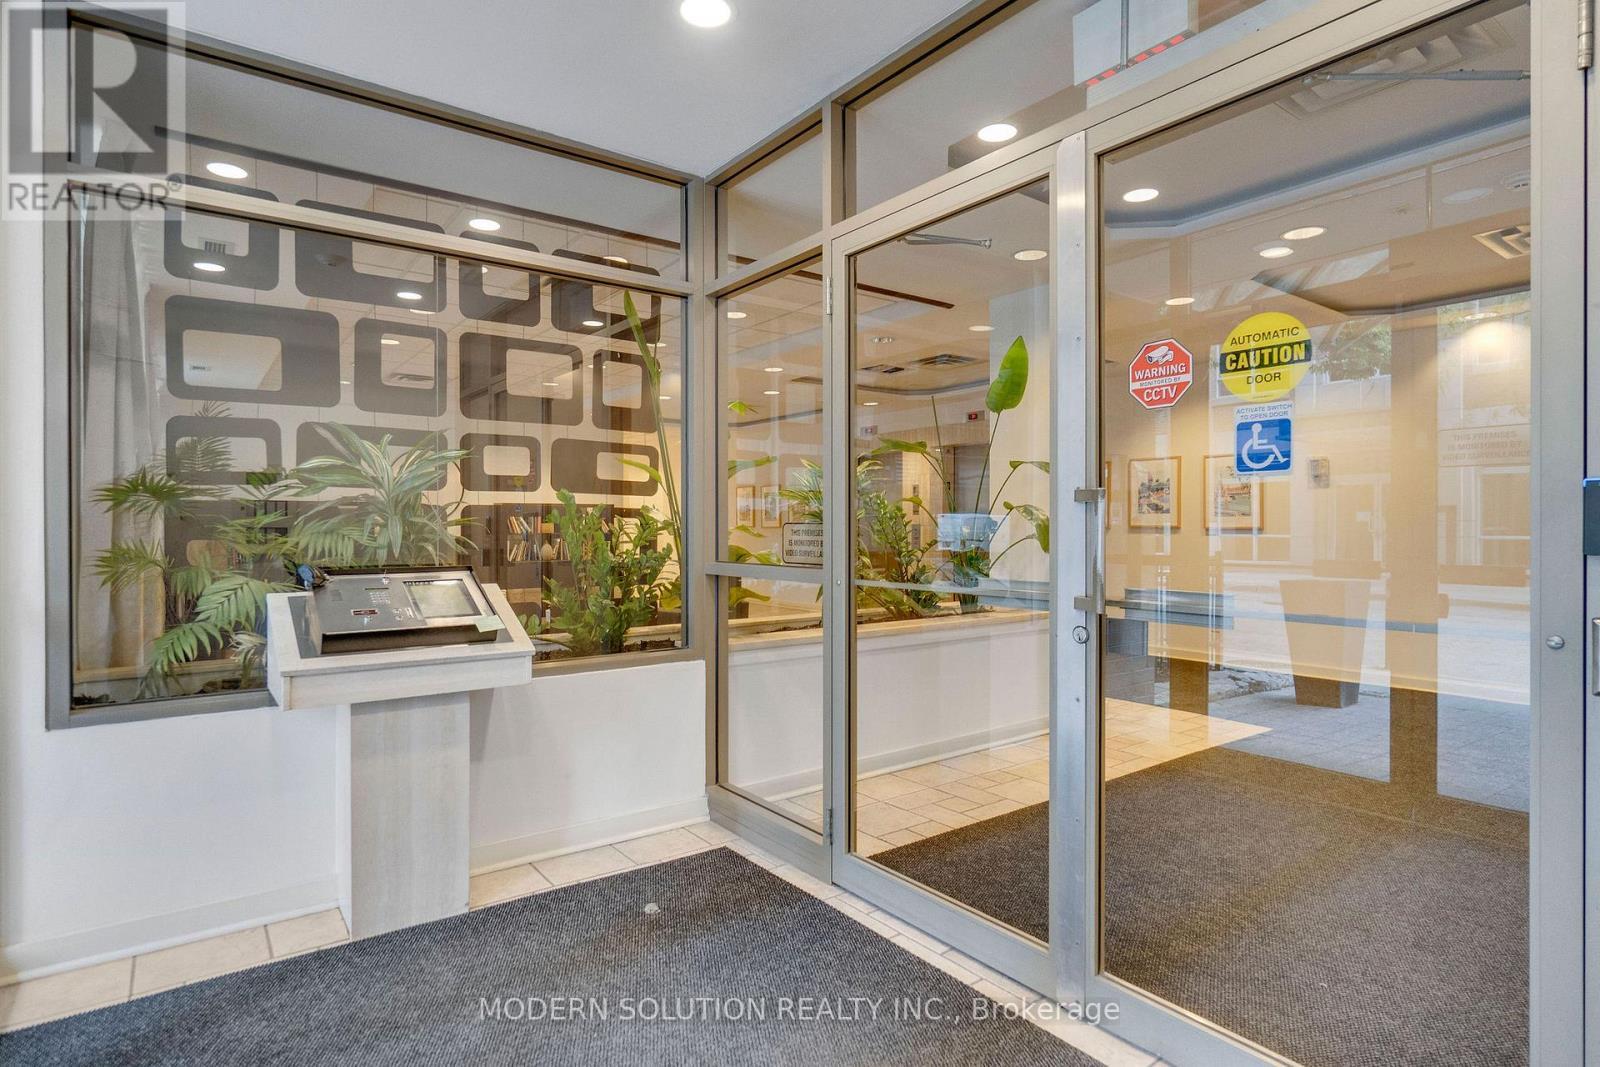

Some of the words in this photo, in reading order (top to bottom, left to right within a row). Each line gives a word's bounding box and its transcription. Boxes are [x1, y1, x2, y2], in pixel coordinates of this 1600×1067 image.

[1230, 326, 1300, 346] AUTOMATIC
[1225, 343, 1306, 370] CAUTION
[1135, 363, 1186, 380] WARNING
[1246, 372, 1281, 384] DOOR
[1140, 378, 1173, 387] MONITORED
[1144, 385, 1178, 401] CCTV
[1236, 406, 1265, 415] ACTIVATE
[1267, 403, 1292, 411] SWITCH
[1269, 410, 1288, 418] DOOR
